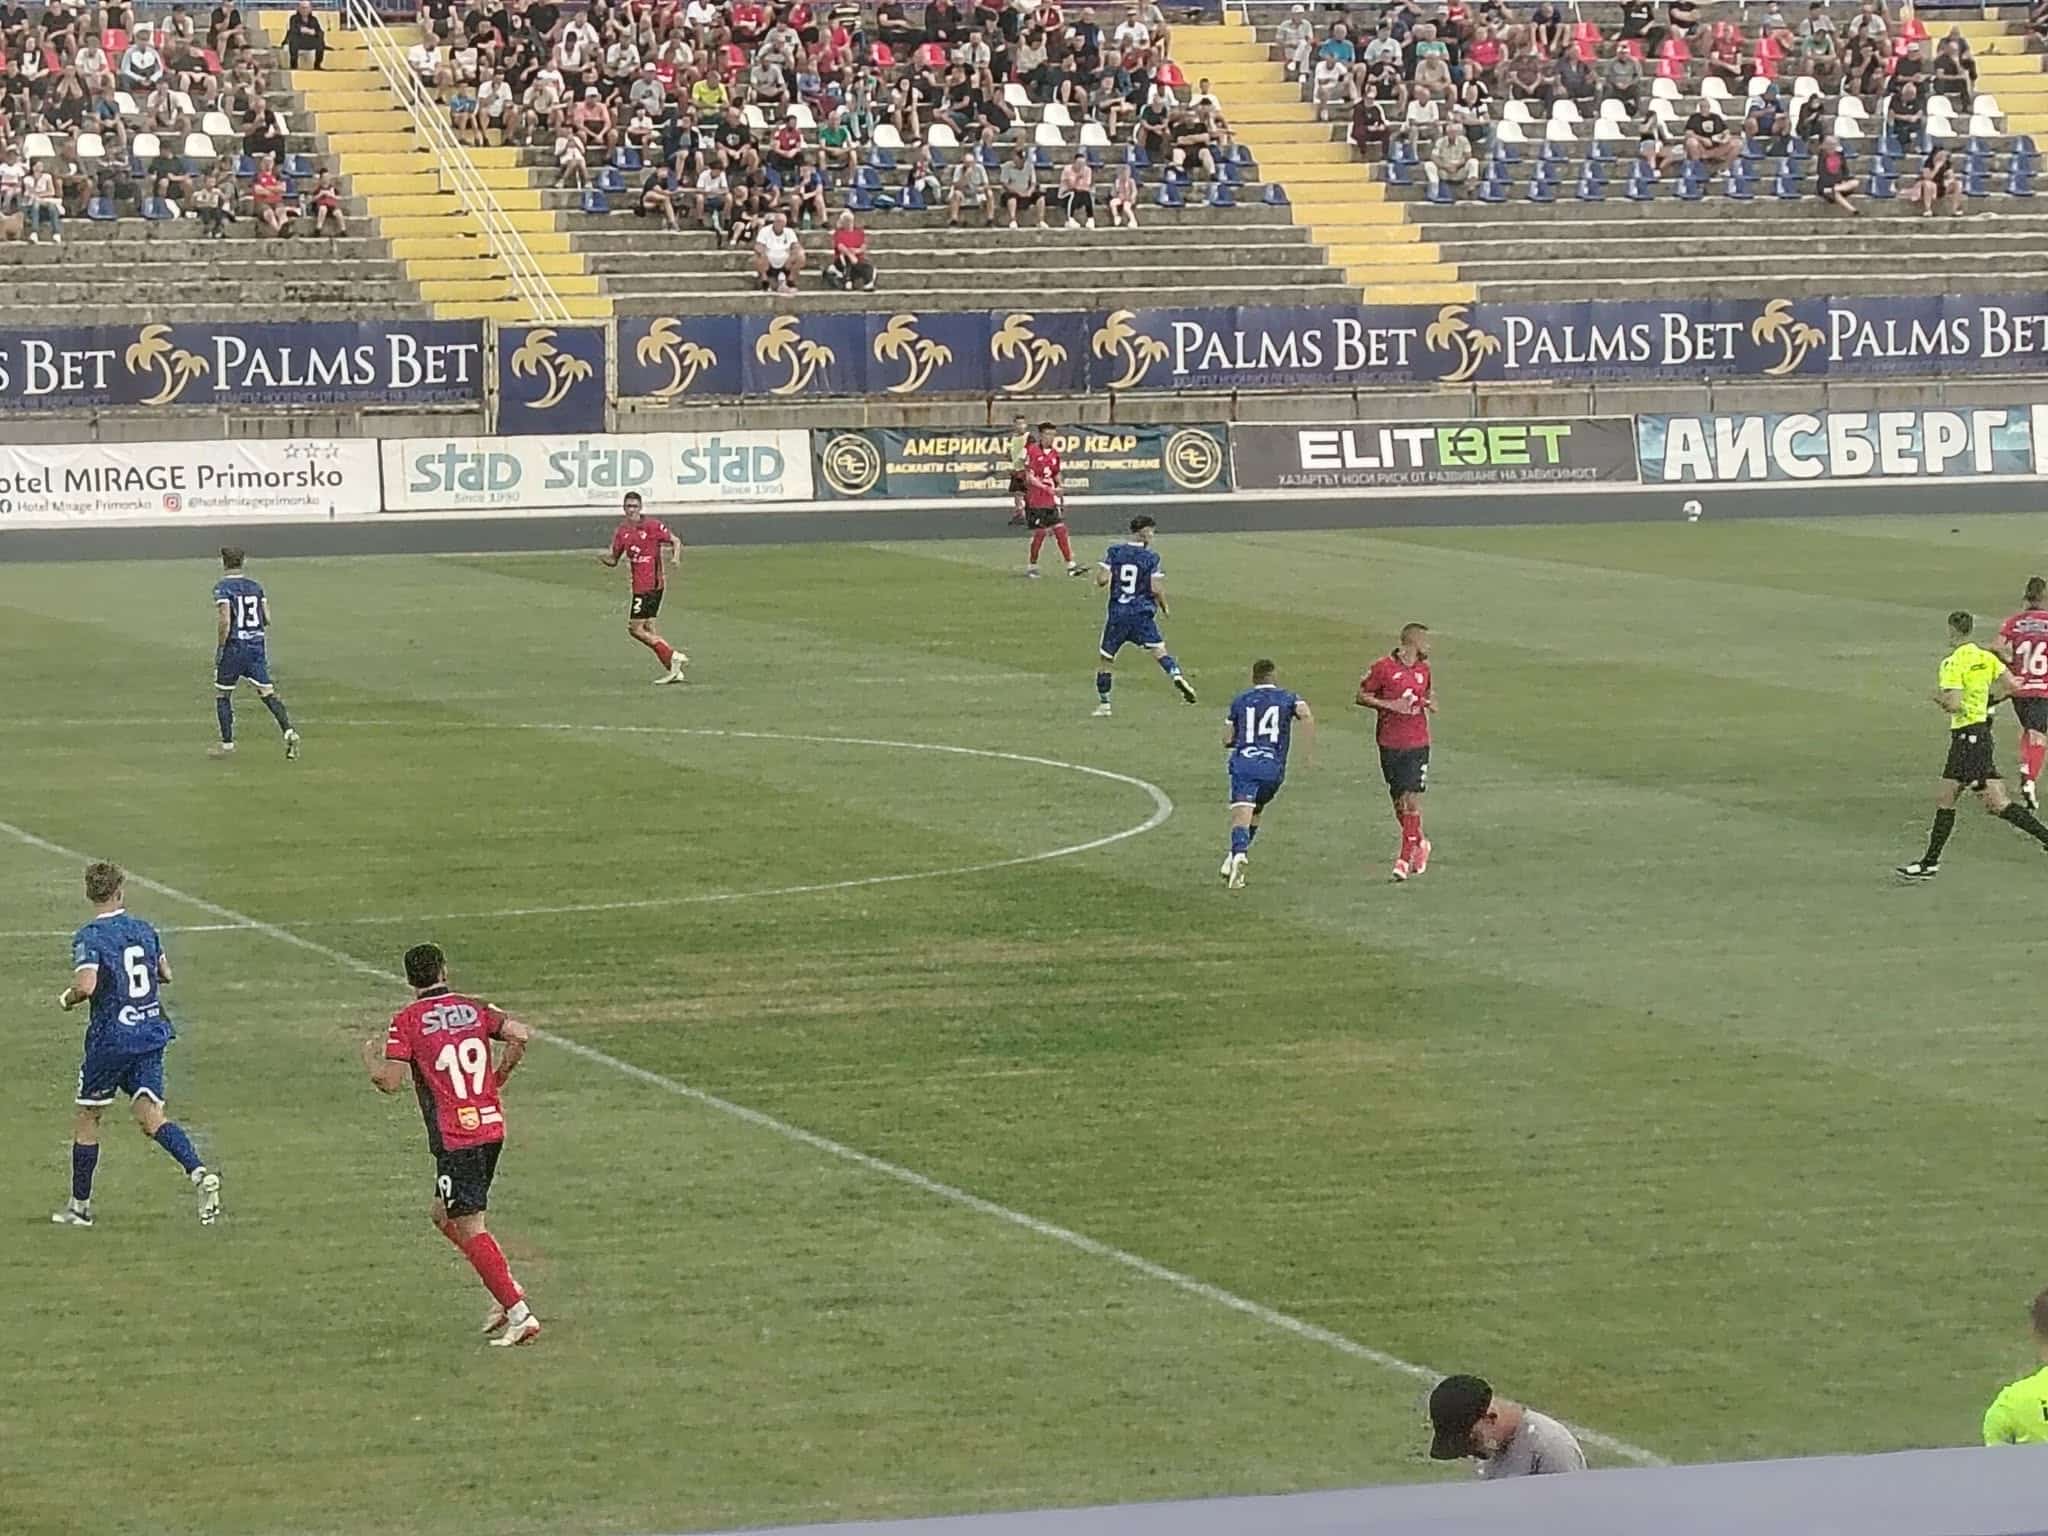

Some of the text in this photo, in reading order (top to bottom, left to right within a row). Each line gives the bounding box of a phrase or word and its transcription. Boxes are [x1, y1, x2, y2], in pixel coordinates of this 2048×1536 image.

[1084, 434, 1137, 453] КЕАР
[1663, 410, 2008, 481] АИСБЕРГ
[65, 466, 186, 493] MIRAGE
[197, 460, 343, 489] Primorsko
[1411, 471, 1425, 482] ОТ
[1501, 470, 1517, 481] НА
[1120, 563, 1138, 594] 9
[237, 595, 260, 628] 13
[2016, 640, 2048, 676] 16
[1245, 705, 1280, 743] 14
[124, 945, 150, 999] 6
[435, 1037, 487, 1100] 19
